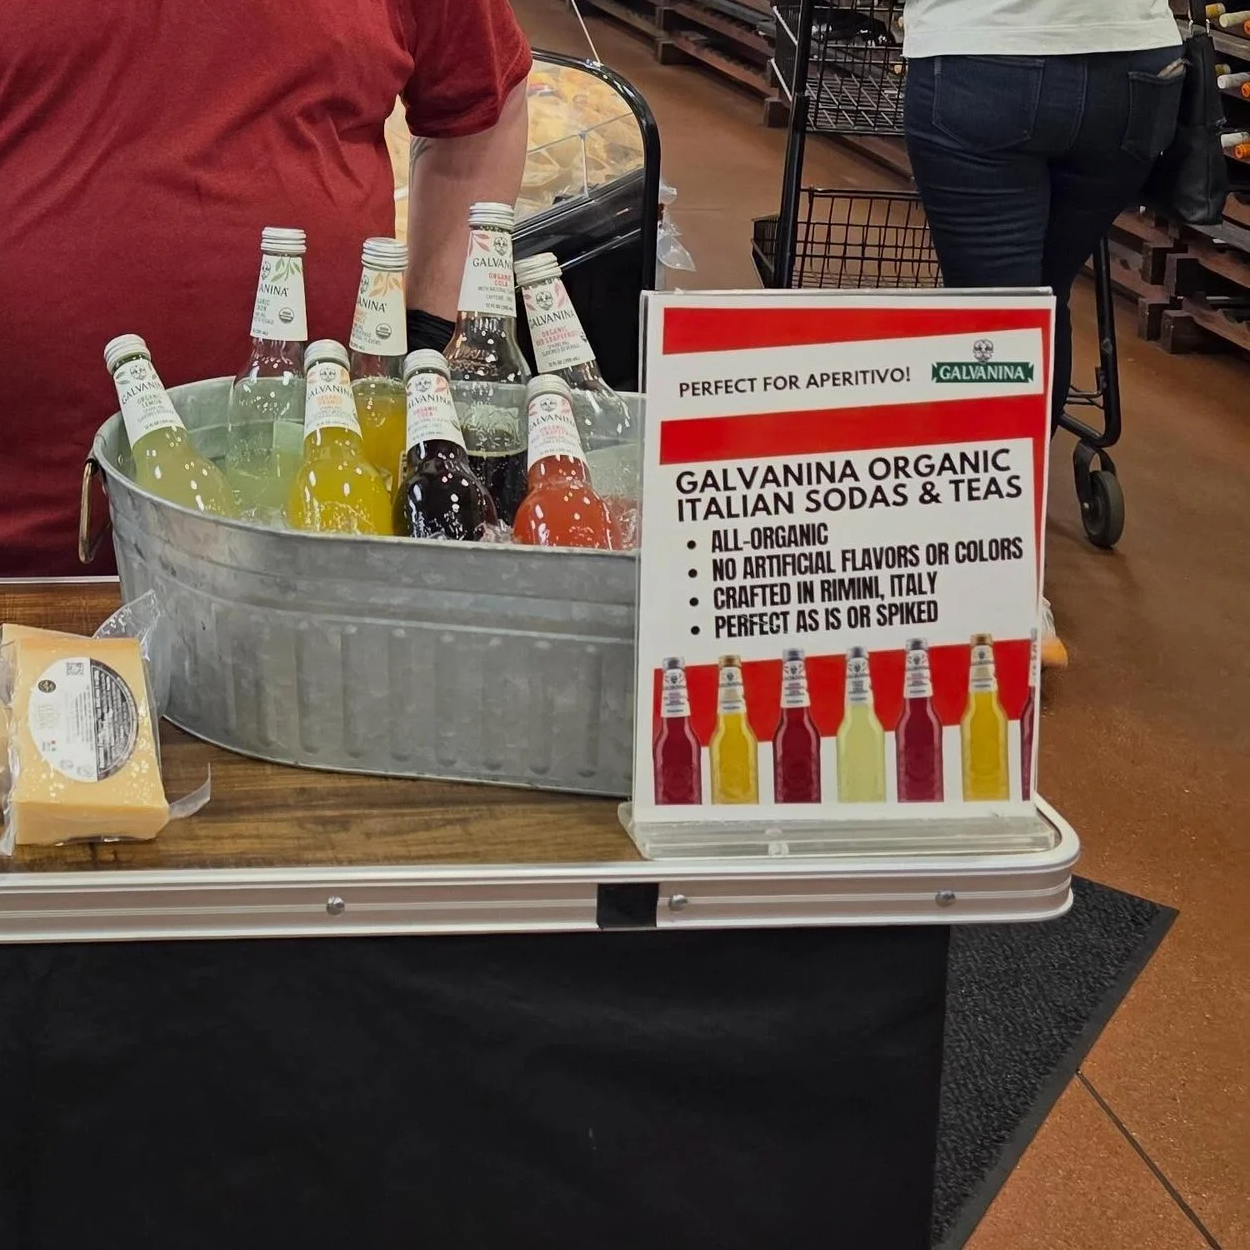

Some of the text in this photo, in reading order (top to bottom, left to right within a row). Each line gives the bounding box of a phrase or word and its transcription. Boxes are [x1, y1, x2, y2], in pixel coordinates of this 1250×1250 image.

[679, 364, 1025, 397] PERFECT FOR APERITIVO! GALVANINA
[675, 448, 1011, 495] GALVANINA ORGANIC
[677, 475, 1023, 522] ITALIAN SODAS & TEAS
[711, 522, 829, 553] ALL-ORGANIC
[712, 536, 1024, 582] NO ARTIFICIAL FLAVORS OR COLORS
[713, 571, 938, 611] CRAFTED IN RIMINI, ITALY
[715, 600, 938, 639] PERFECT AS IS OR SPIKED
